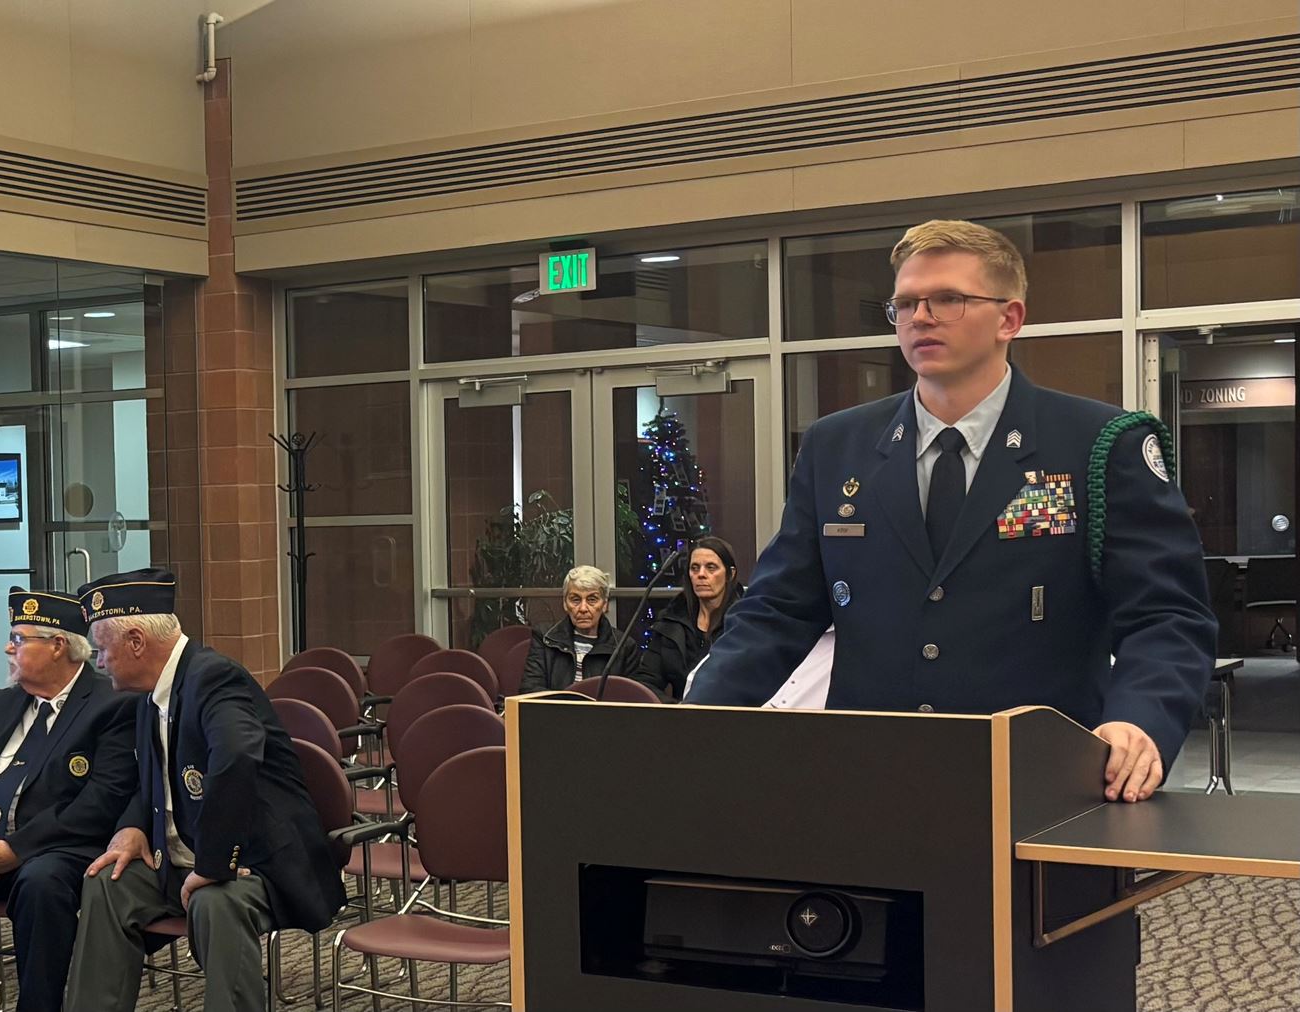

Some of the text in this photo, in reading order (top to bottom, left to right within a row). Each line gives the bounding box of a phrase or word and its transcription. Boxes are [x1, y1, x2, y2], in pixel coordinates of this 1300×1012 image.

[548, 253, 589, 290] EXIT
[1200, 386, 1246, 404] ZONING
[129, 606, 143, 614] PA.
